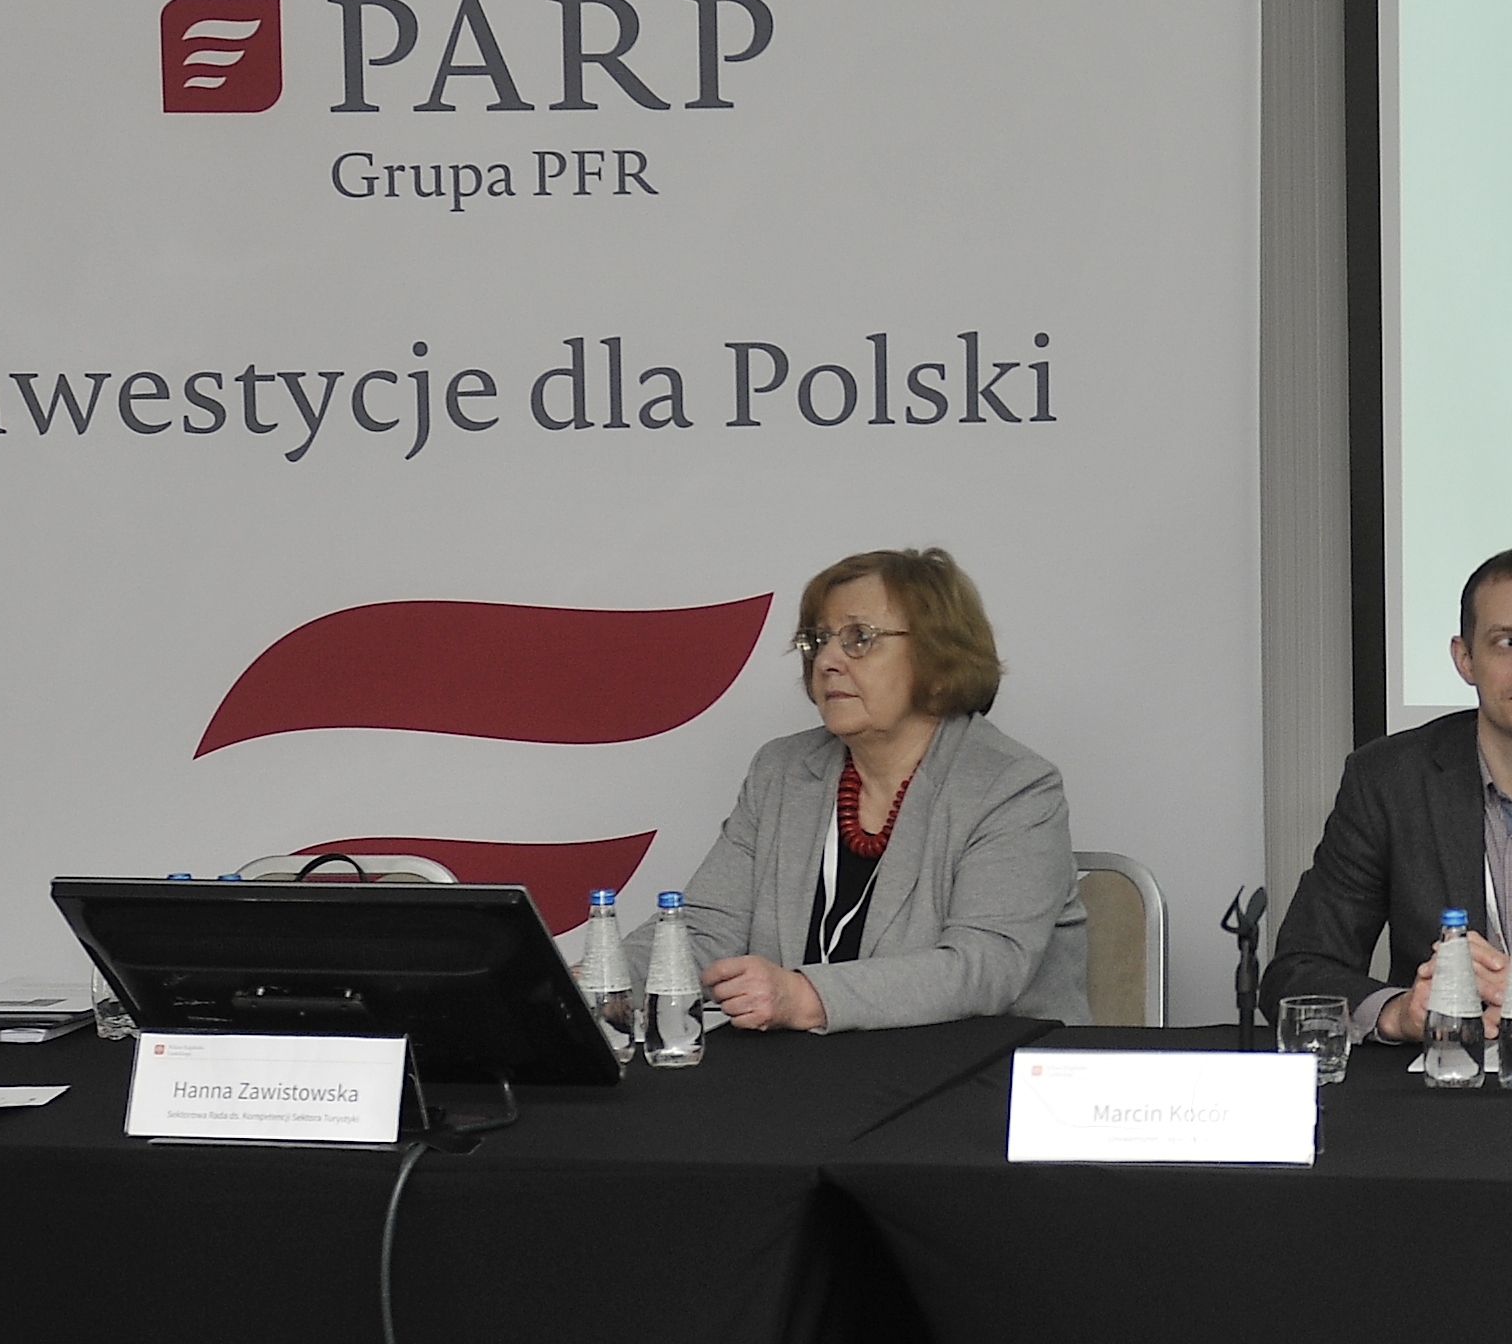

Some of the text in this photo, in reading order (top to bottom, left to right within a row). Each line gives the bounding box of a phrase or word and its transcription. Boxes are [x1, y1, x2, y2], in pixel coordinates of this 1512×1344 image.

[331, 150, 658, 212] Grupa PFR
[530, 337, 693, 430] dla
[725, 331, 1058, 428] Polski
[173, 1081, 359, 1103] Hanna Zawistowska
[1094, 1105, 1163, 1123] Marcin
